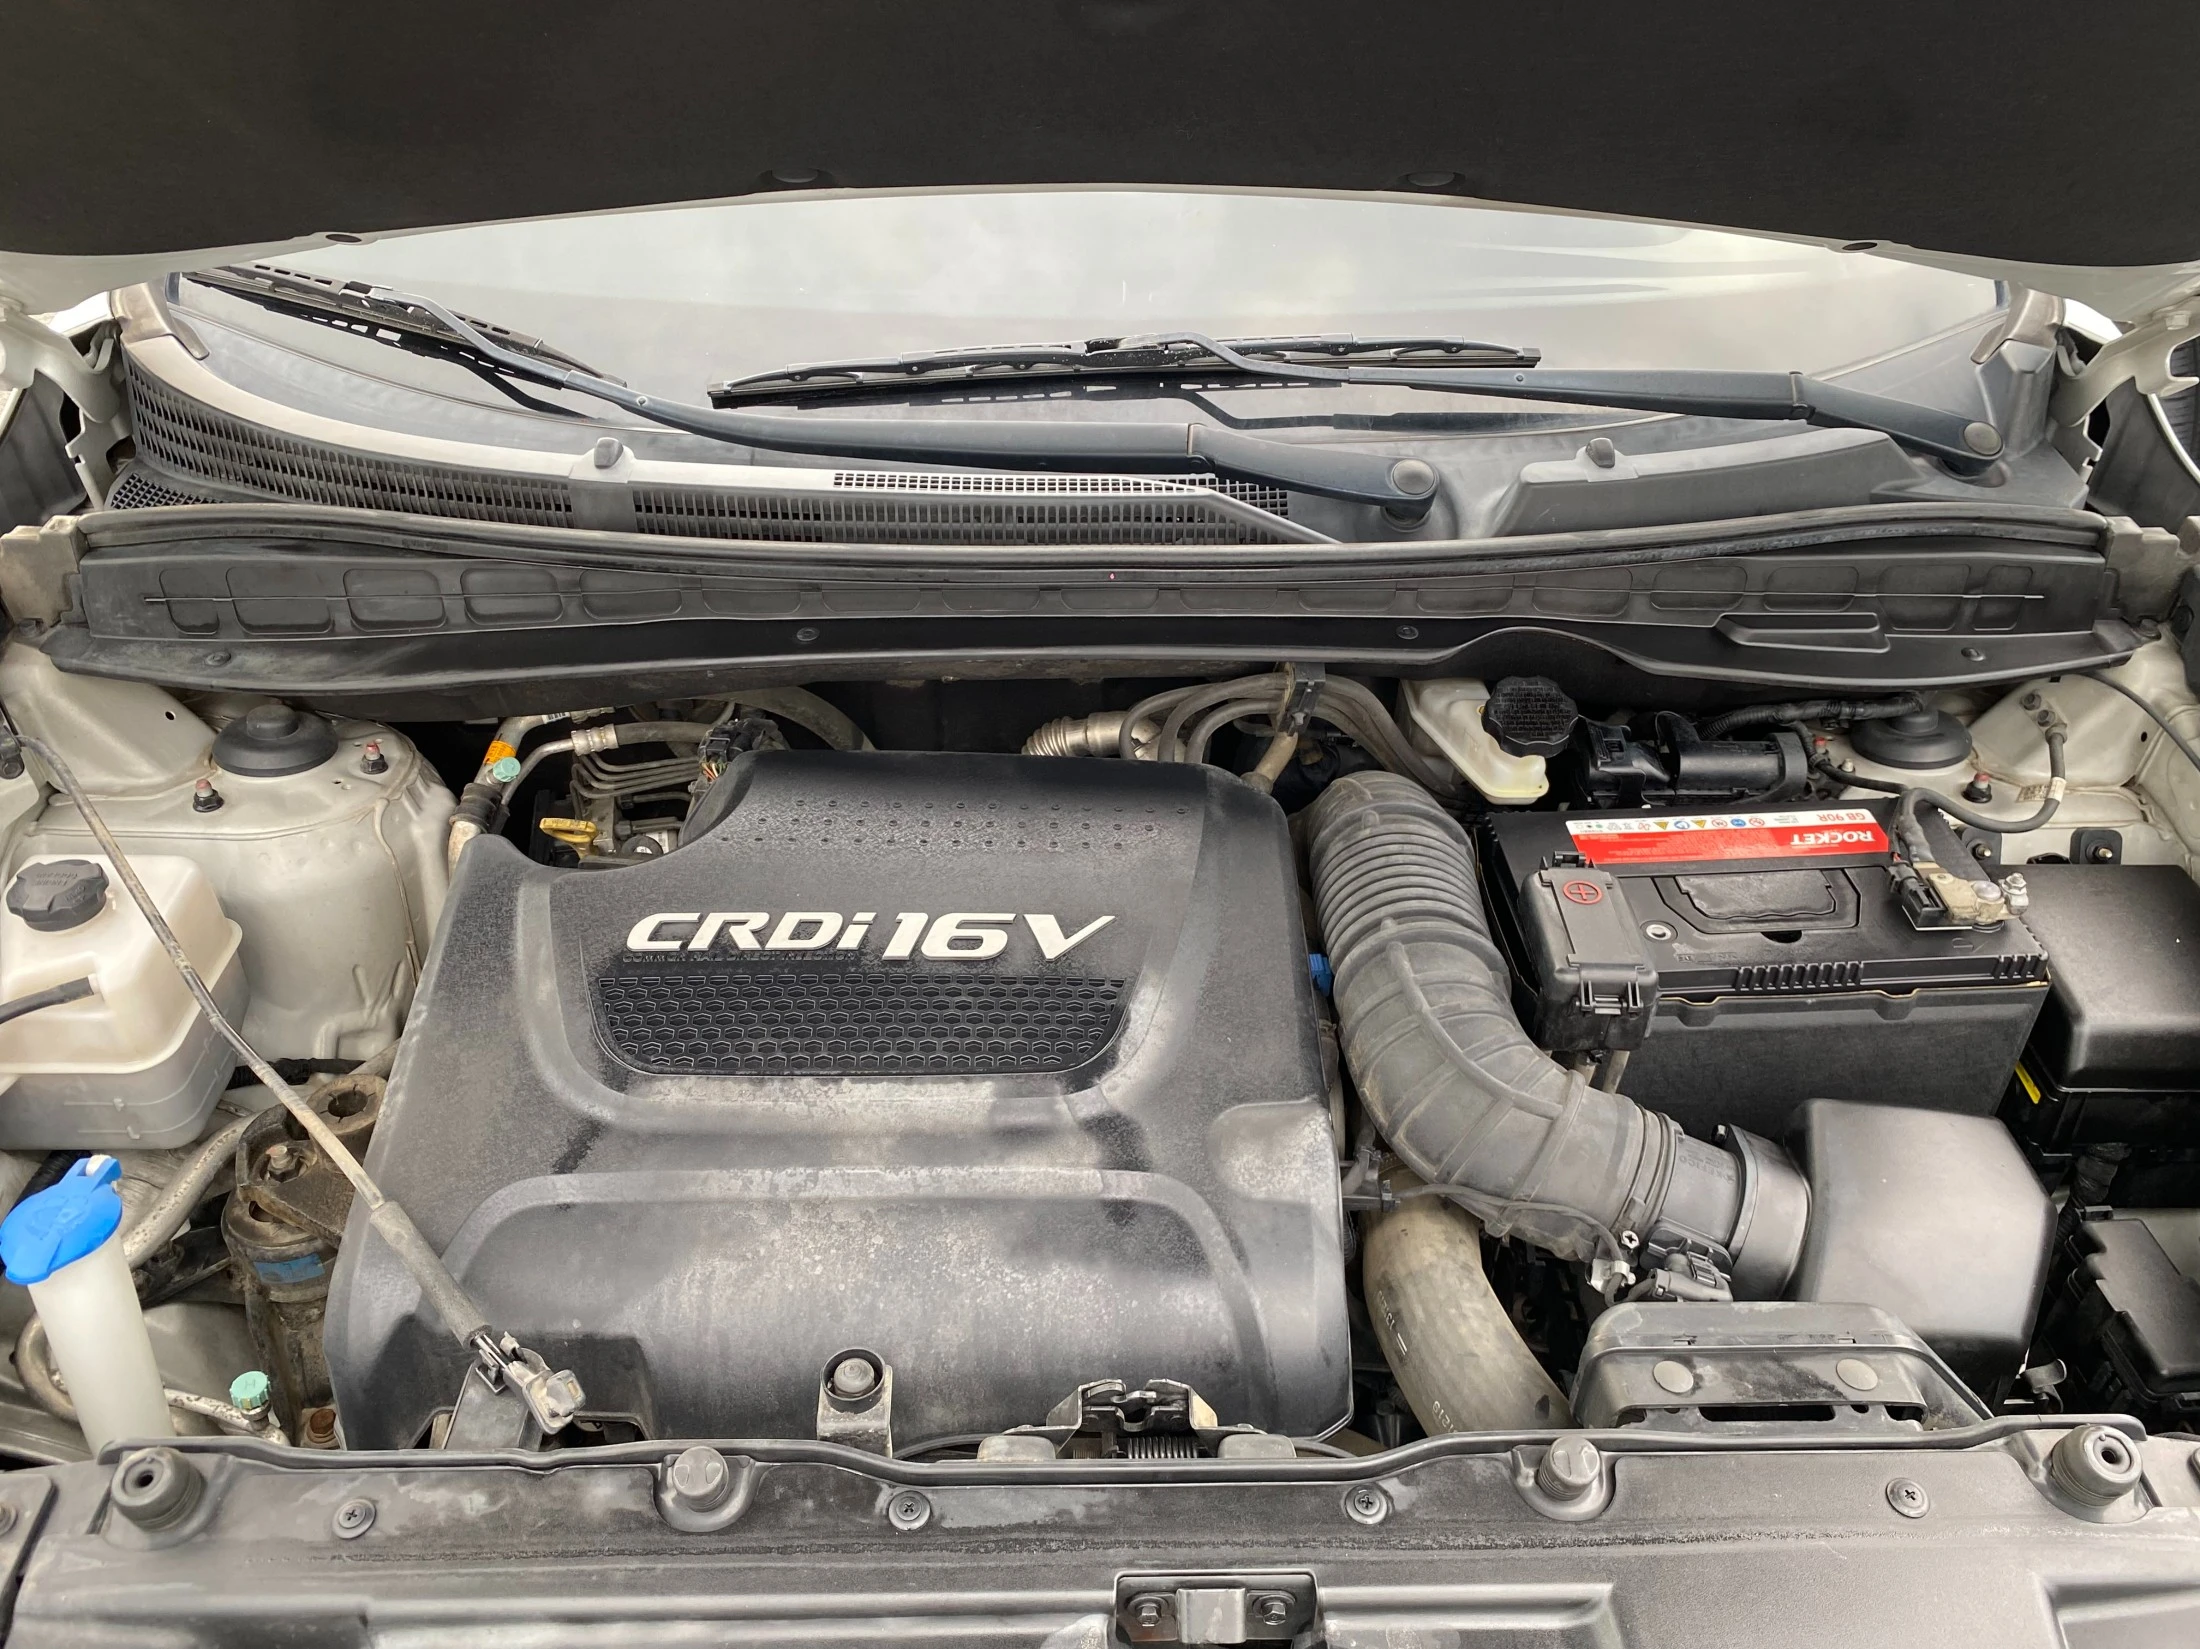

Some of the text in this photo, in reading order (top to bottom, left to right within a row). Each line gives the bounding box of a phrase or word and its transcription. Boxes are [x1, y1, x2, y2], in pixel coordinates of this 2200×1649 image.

[1816, 812, 1866, 822] GB 90R
[1790, 830, 1876, 846] ROCKET
[626, 912, 877, 951] CRDi
